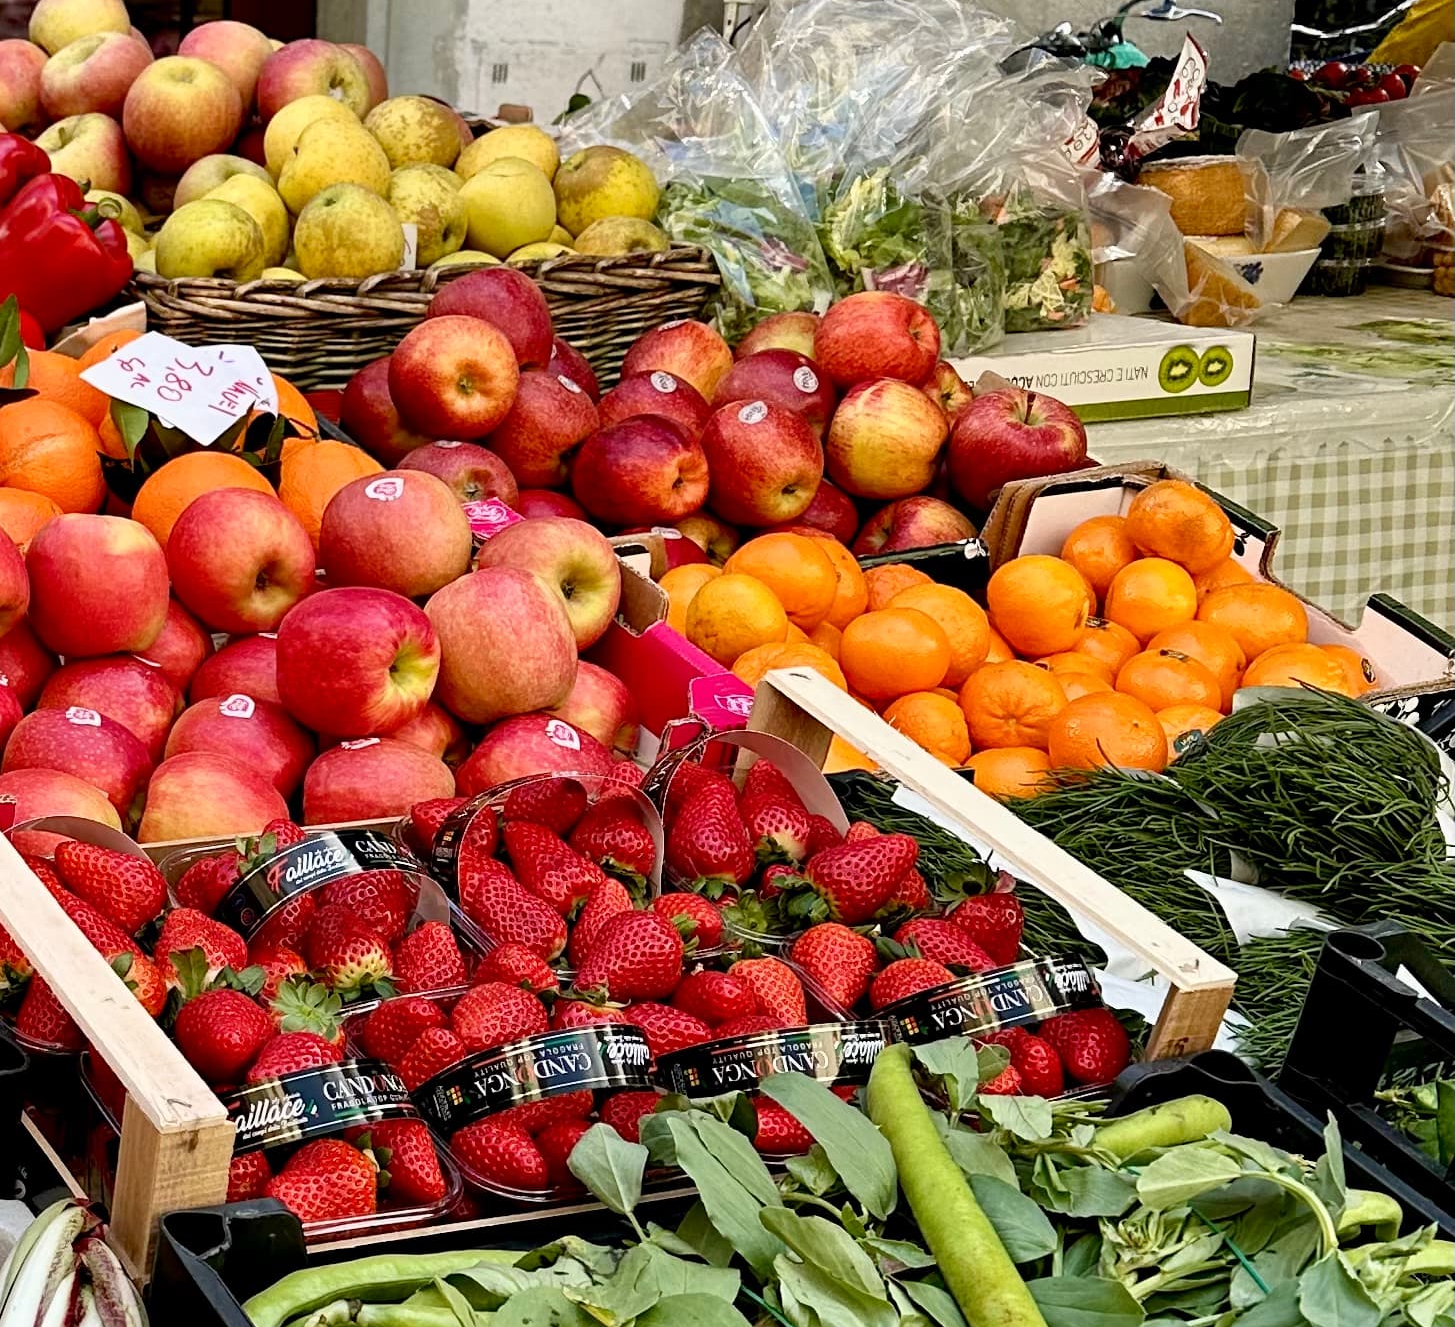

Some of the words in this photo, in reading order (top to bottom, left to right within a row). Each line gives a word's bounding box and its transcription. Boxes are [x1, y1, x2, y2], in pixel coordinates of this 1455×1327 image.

[156, 357, 215, 402] 3,80
[1036, 372, 1059, 389] CON
[1060, 368, 1113, 387] CRESCIUTI
[1115, 367, 1123, 382] E
[1125, 365, 1149, 380] NATI
[474, 1052, 592, 1097] CANDONGA
[711, 1050, 829, 1085] CANDONGA
